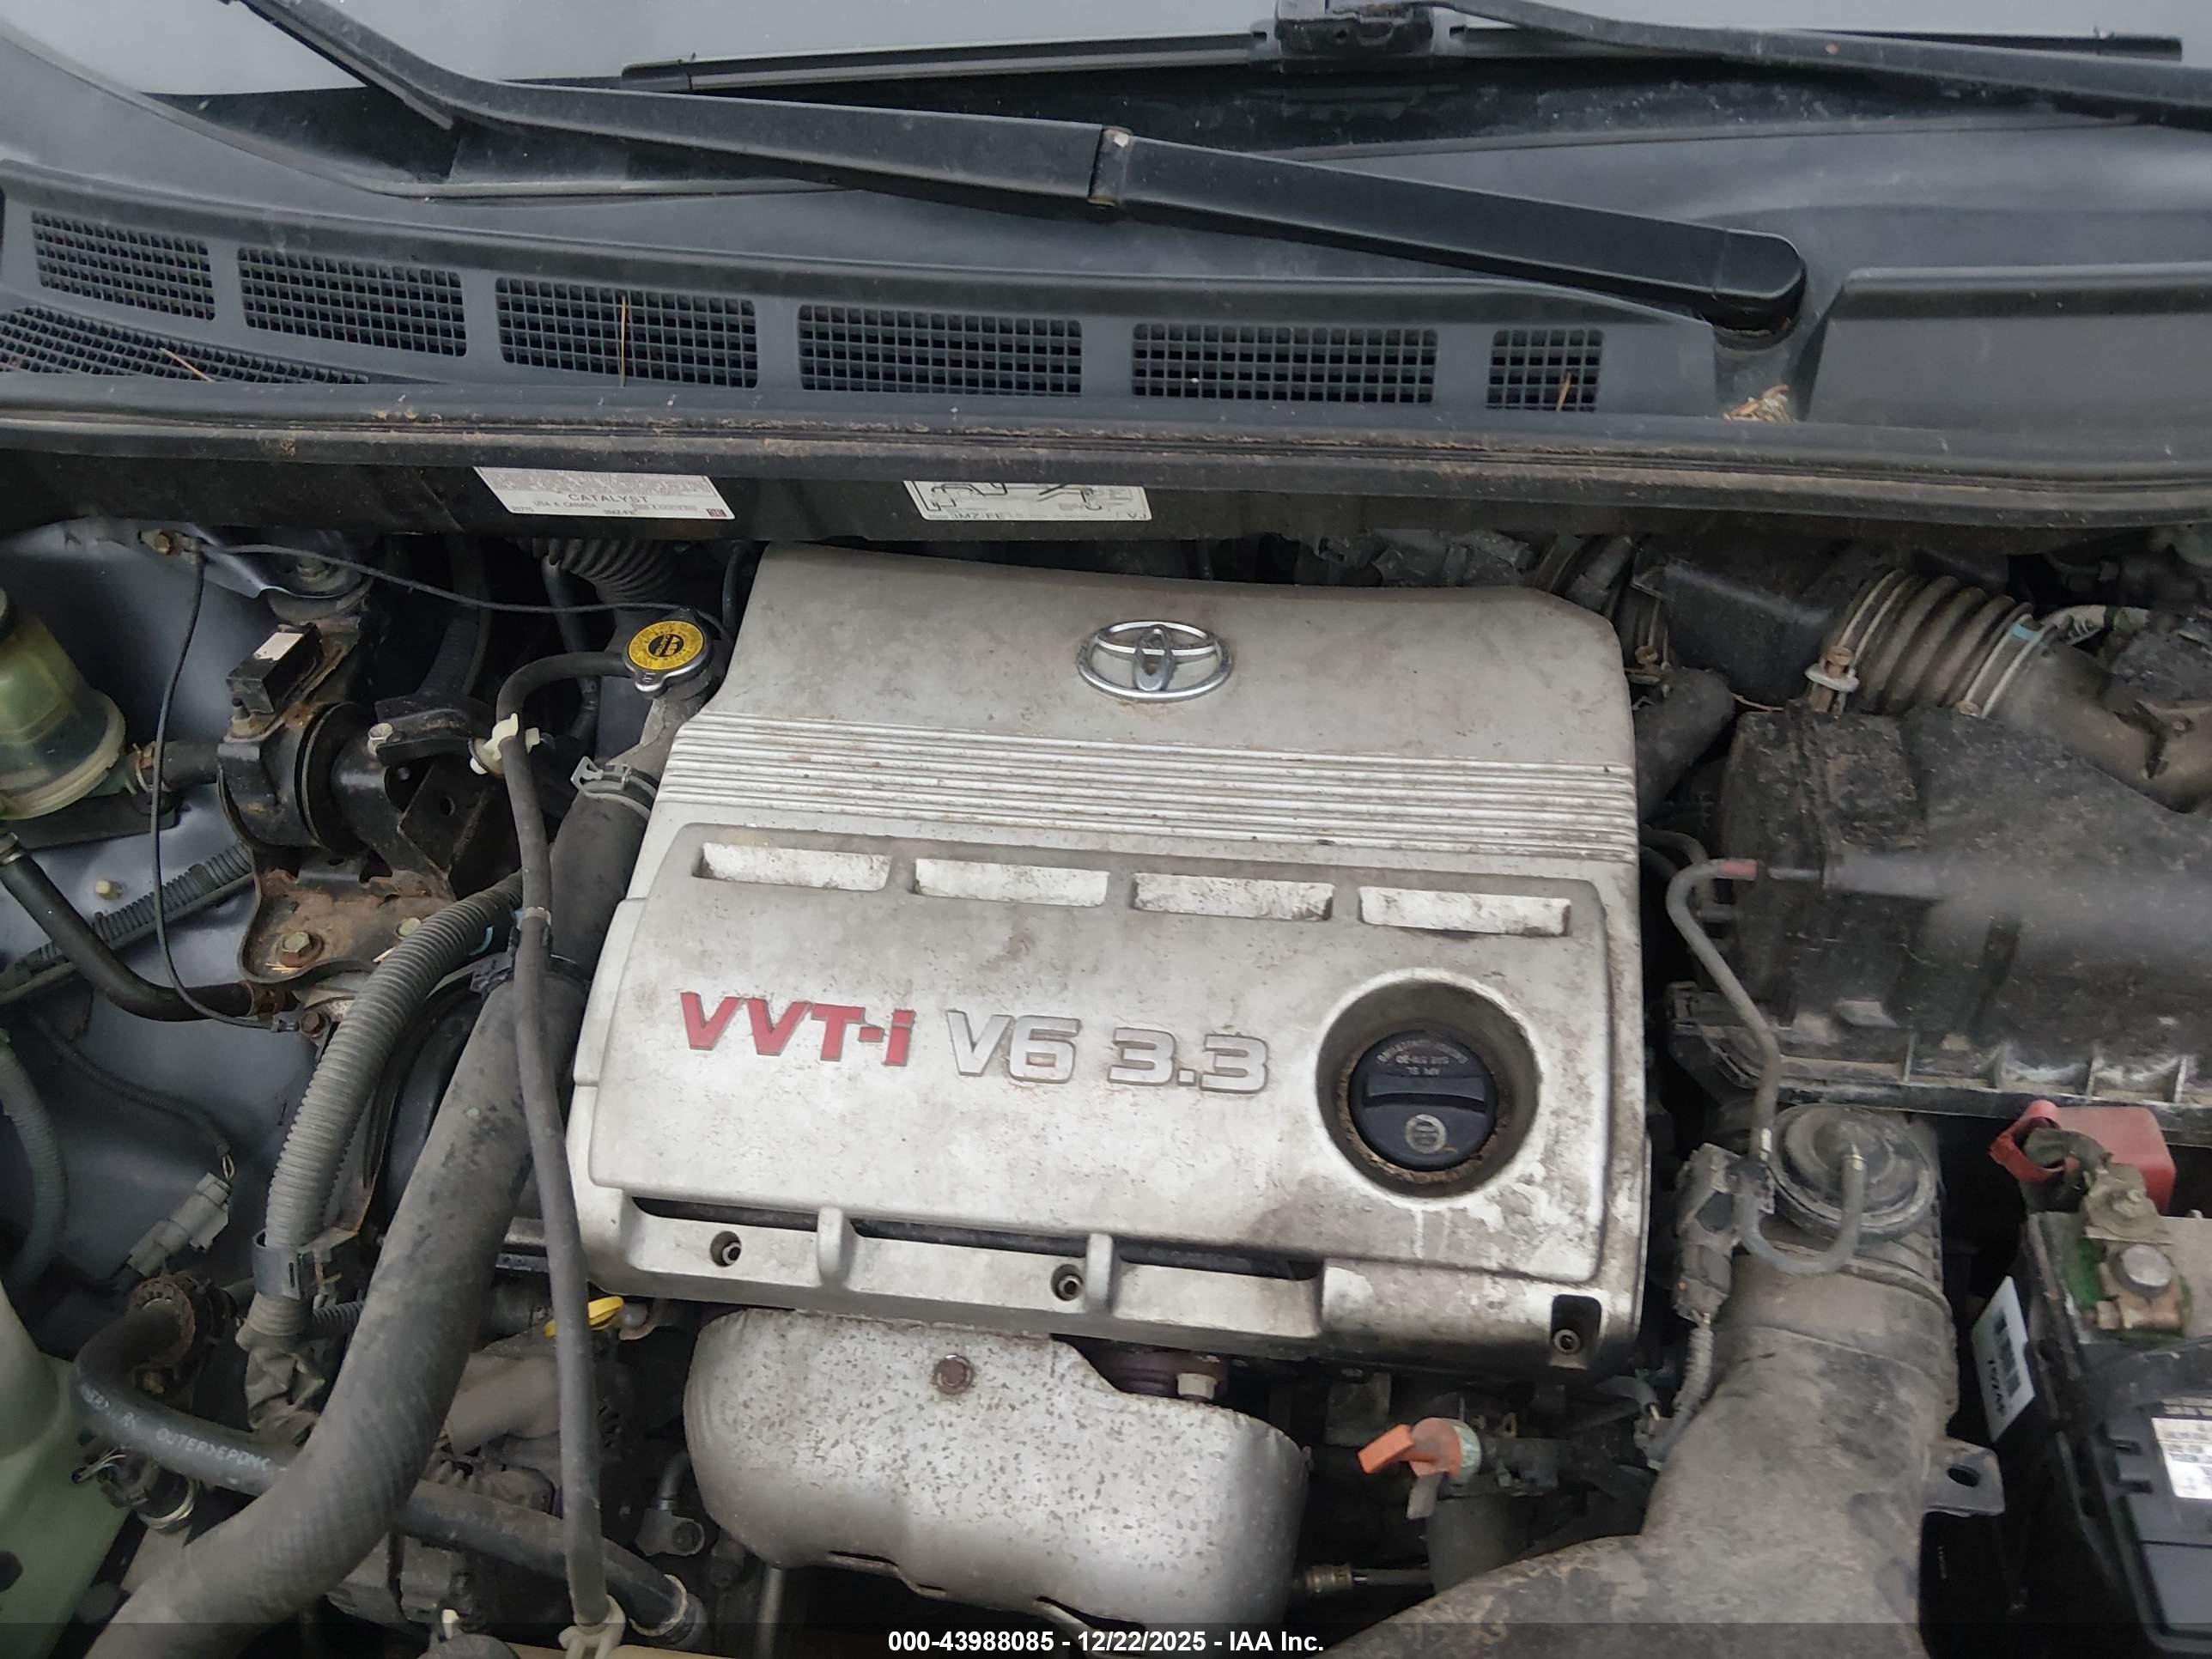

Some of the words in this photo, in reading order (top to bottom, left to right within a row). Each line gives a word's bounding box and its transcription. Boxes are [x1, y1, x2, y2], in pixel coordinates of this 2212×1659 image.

[568, 493, 648, 503] CATALYST
[945, 1009, 1082, 1085] V6
[1107, 1027, 1269, 1095] 3.3
